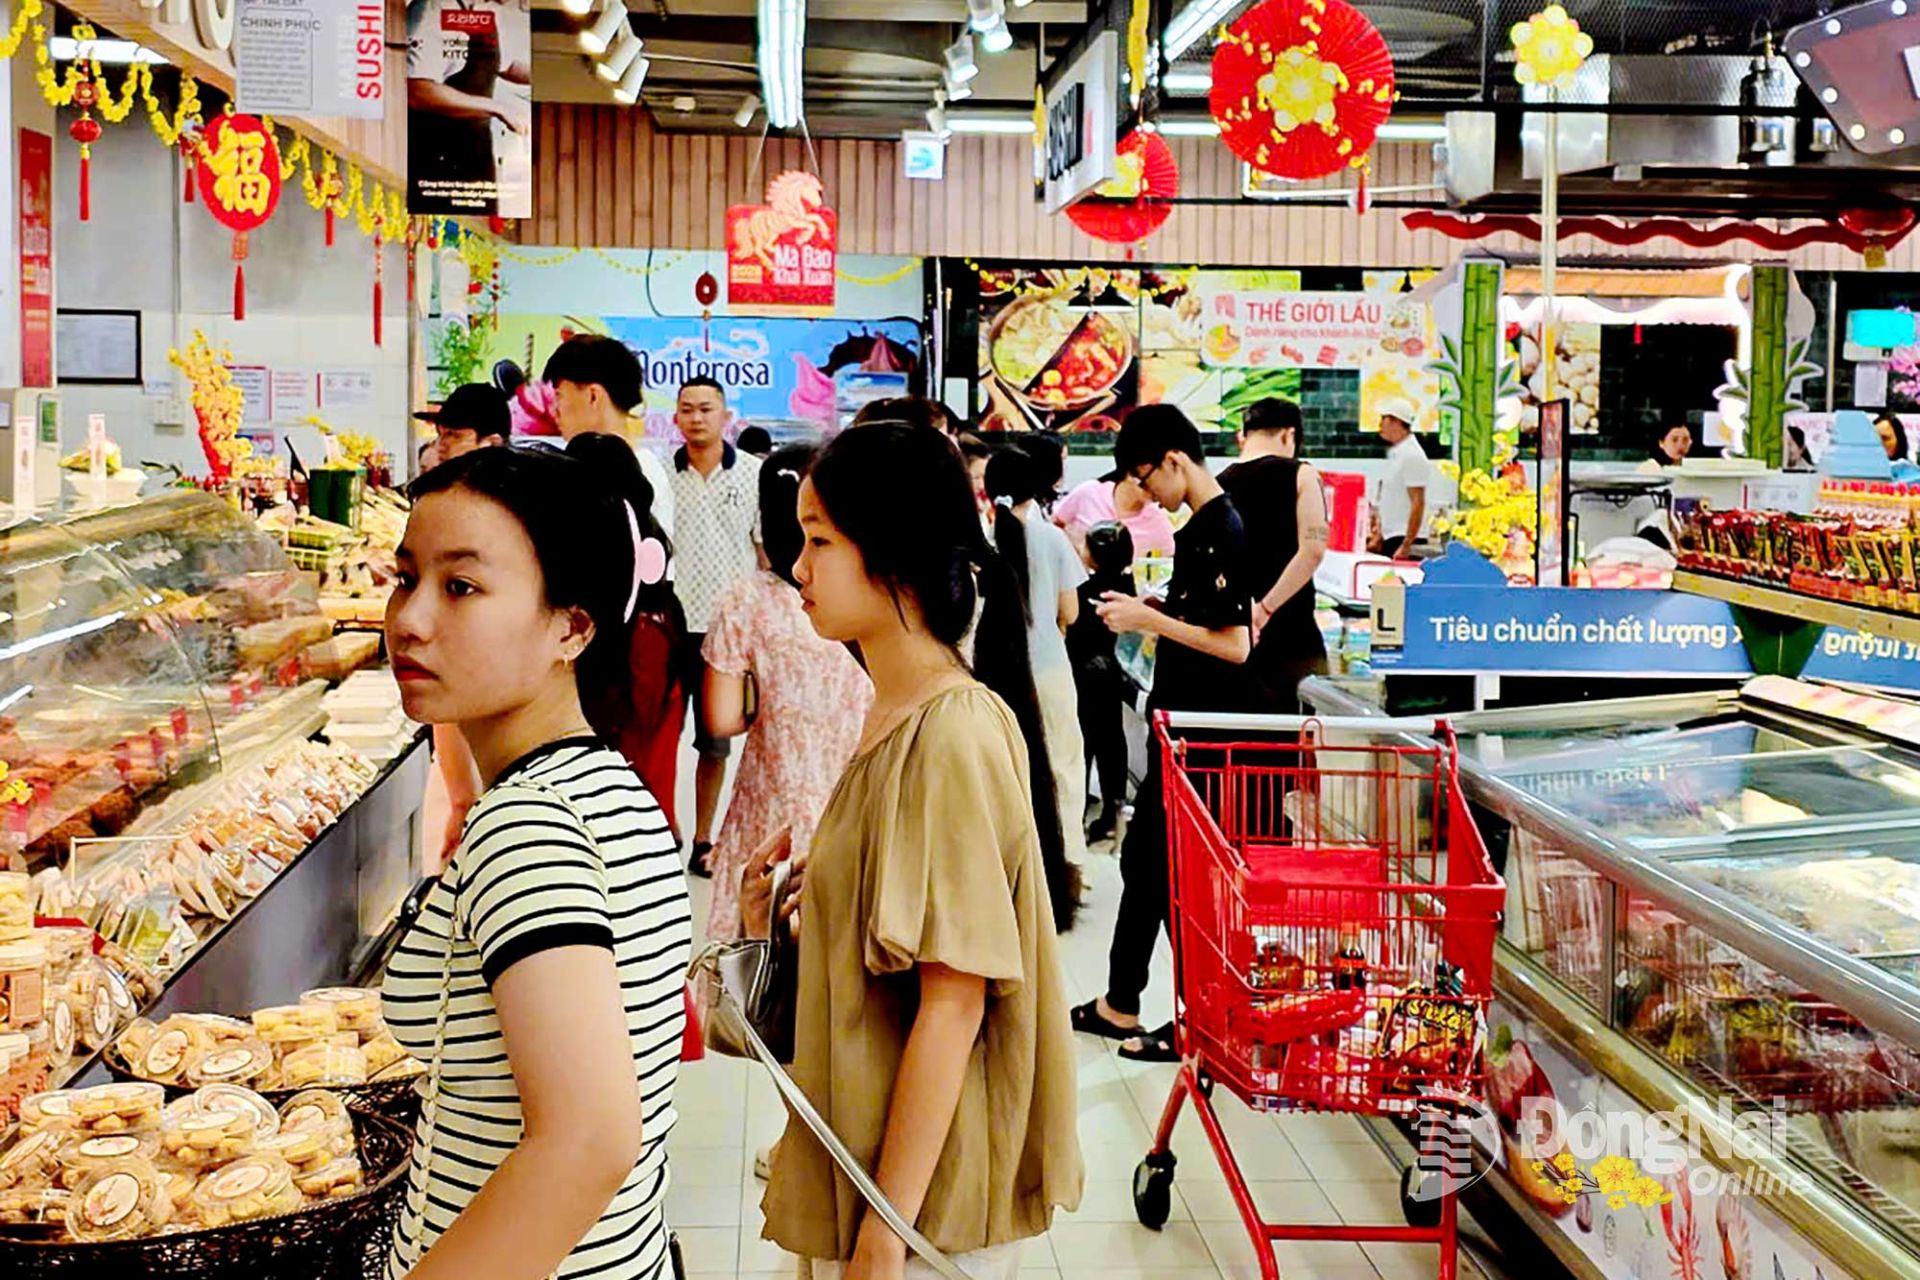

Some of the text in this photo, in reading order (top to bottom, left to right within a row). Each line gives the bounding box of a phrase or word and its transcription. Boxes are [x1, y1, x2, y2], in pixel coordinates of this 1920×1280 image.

[356, 4, 382, 99] SUSHI
[208, 121, 271, 216] 福
[1245, 298, 1287, 323] THẾ
[1291, 298, 1335, 323] GIỚI
[1376, 608, 1396, 632] L
[1429, 616, 1488, 644] Tiêu
[1493, 613, 1577, 645] chuẩn
[1582, 615, 1645, 645] chất
[1650, 619, 1727, 649] lượng
